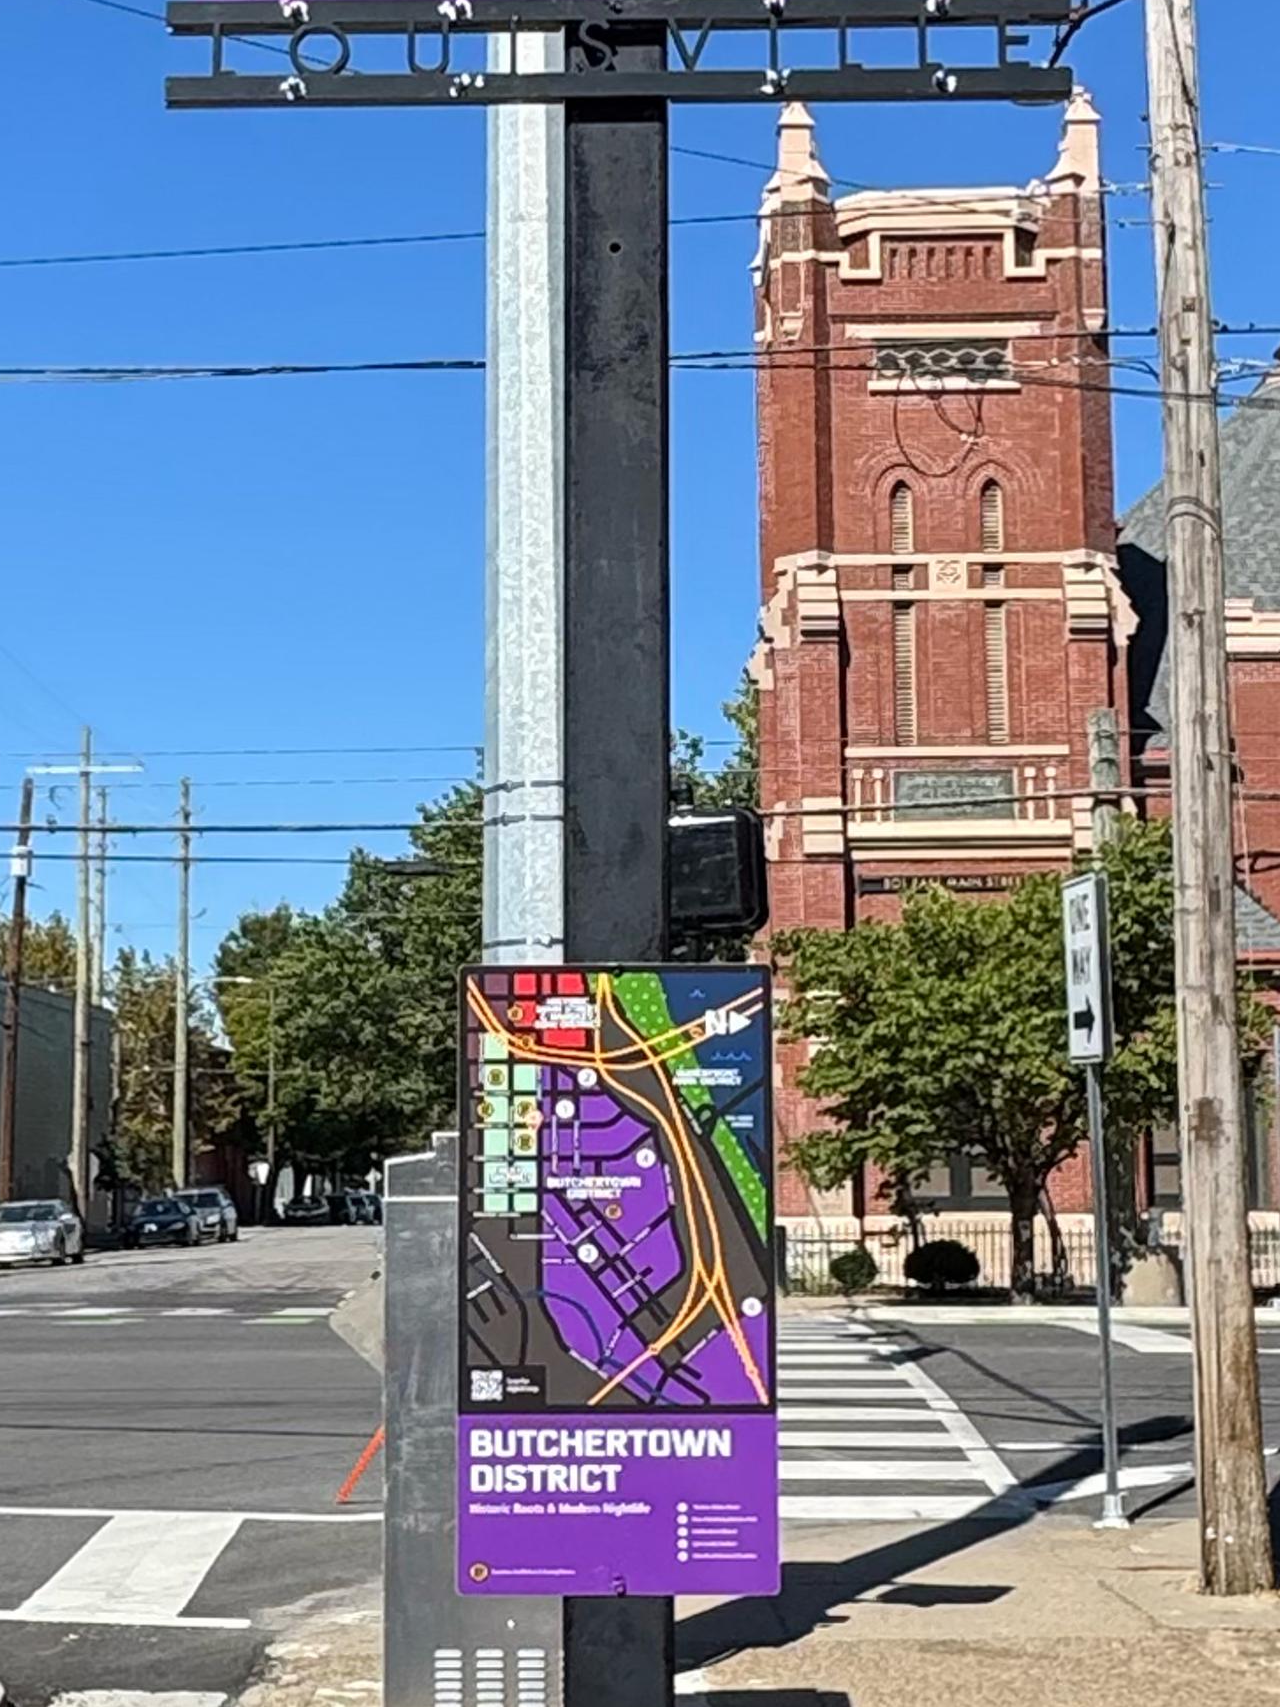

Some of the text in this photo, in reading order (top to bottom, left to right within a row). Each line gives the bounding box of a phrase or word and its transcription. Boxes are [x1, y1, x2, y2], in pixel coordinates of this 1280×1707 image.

[209, 15, 1034, 76] LOUISVILLE
[470, 1429, 731, 1458] BUTCHERTOWN
[470, 1464, 622, 1493] DISTRICT
